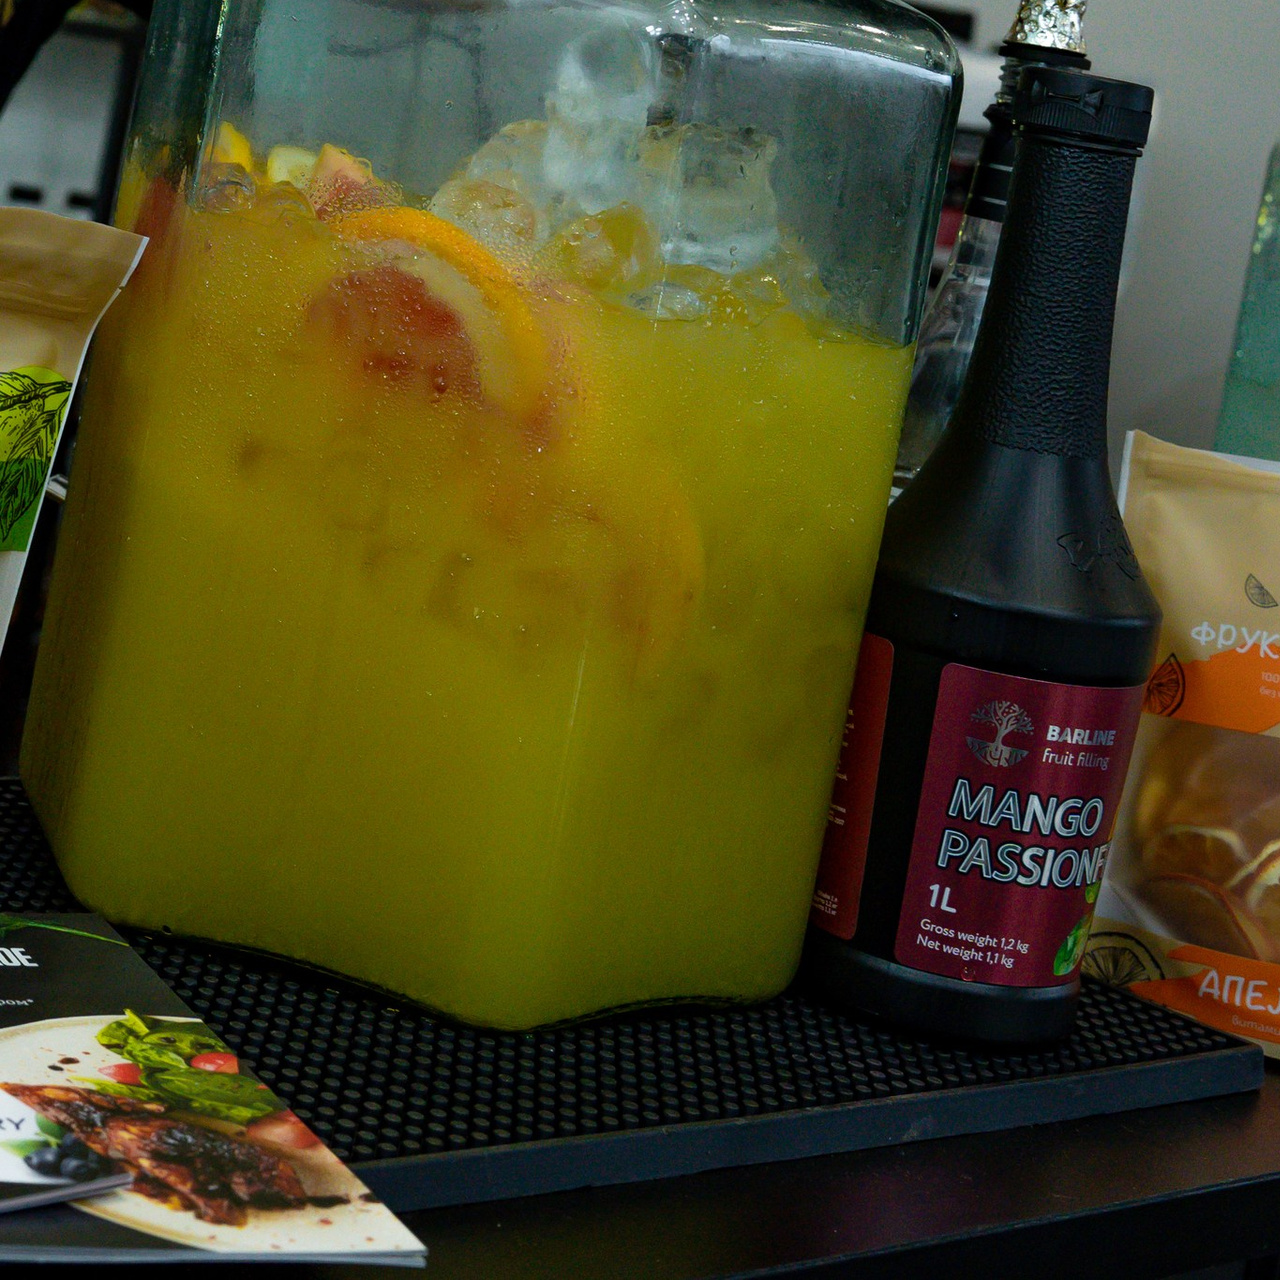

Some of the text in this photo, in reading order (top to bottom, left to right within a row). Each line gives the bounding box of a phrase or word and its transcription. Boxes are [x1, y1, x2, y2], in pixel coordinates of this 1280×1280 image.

[1046, 725, 1117, 746] BARLINE
[1042, 747, 1110, 771] fruit filling
[948, 778, 1104, 837] MANGO
[929, 883, 957, 914] 1L
[916, 934, 1015, 969] Net weight 1,1 kg
[920, 919, 1030, 954] Gross weight 1,2 kg
